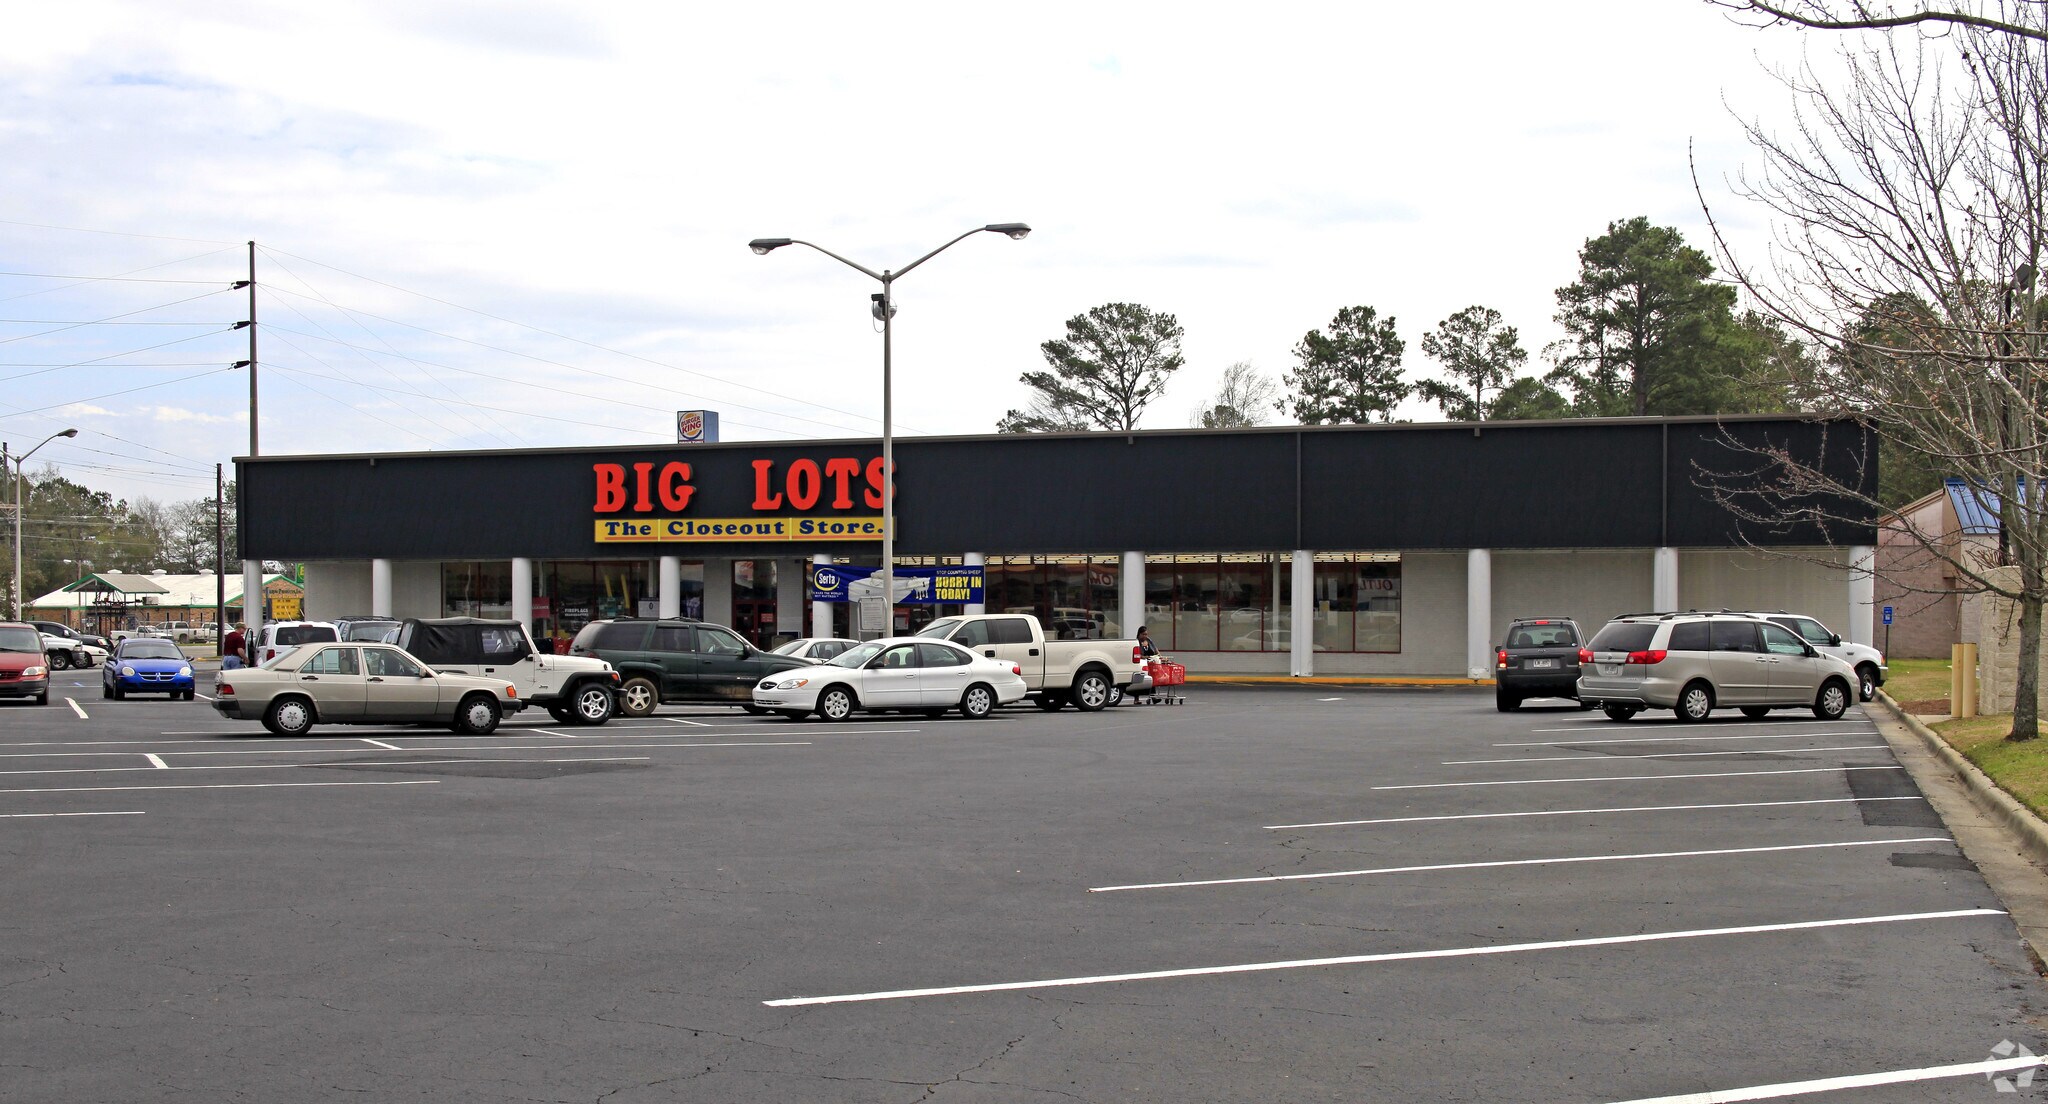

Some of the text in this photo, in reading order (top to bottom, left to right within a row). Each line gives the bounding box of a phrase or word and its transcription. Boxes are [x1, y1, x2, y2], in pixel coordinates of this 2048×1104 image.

[680, 415, 701, 428] BURGER
[681, 420, 702, 434] KING
[593, 456, 896, 512] BIG LOTS
[605, 519, 884, 536] The Closeout Store.
[818, 573, 836, 585] Serta
[935, 576, 982, 588] HURRY IN
[935, 588, 970, 600] TODAY!
